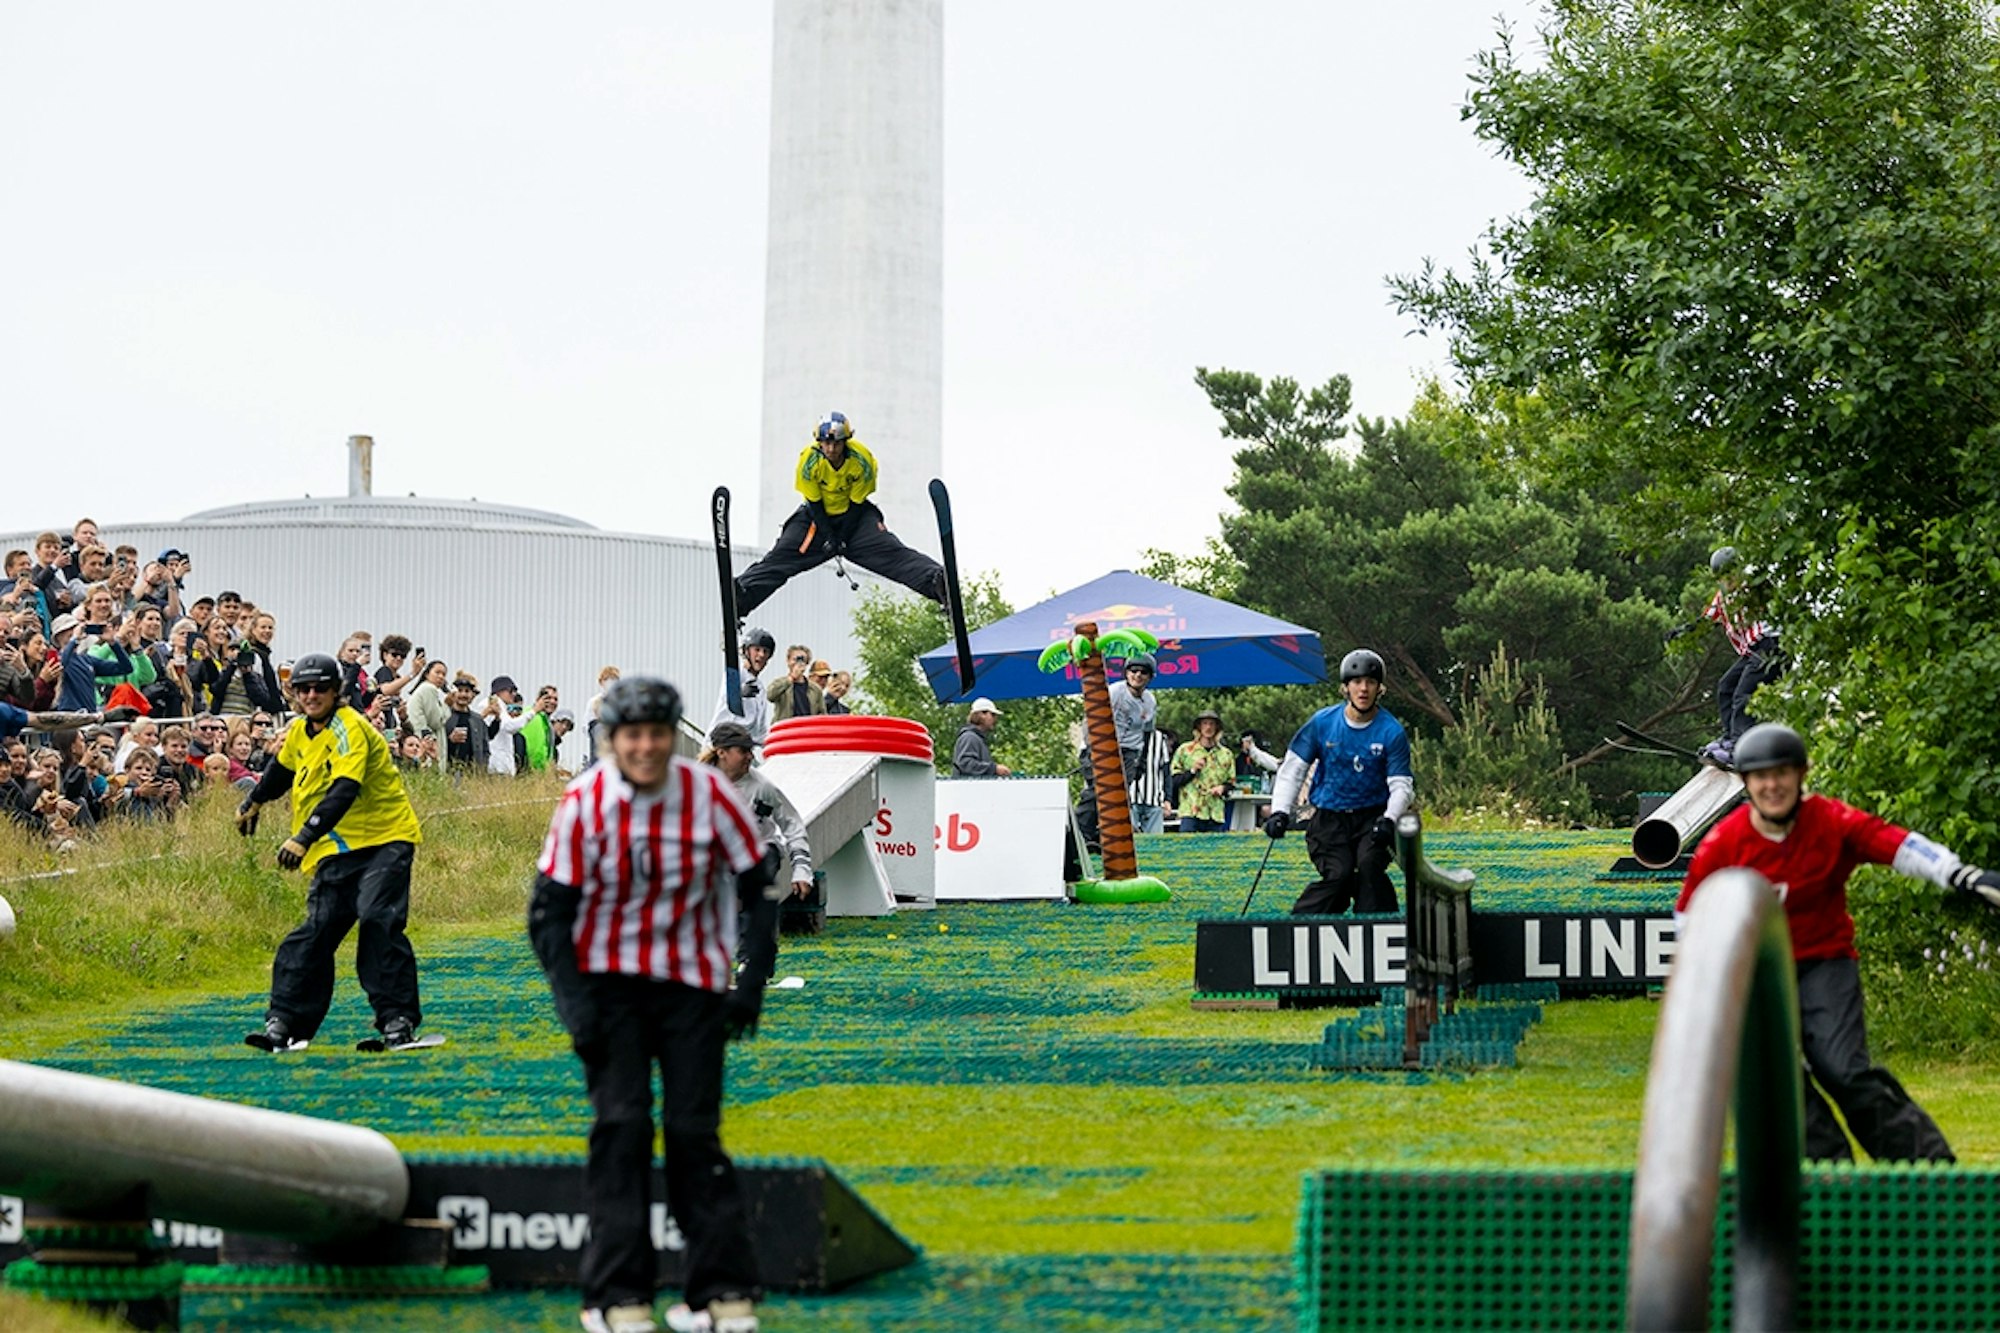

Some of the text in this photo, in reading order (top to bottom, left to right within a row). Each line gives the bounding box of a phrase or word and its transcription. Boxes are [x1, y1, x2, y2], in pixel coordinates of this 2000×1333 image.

[716, 496, 727, 548] HEAD
[1353, 754, 1365, 773] 6
[1252, 924, 1406, 985] LINE
[1525, 919, 1676, 977] LINE
